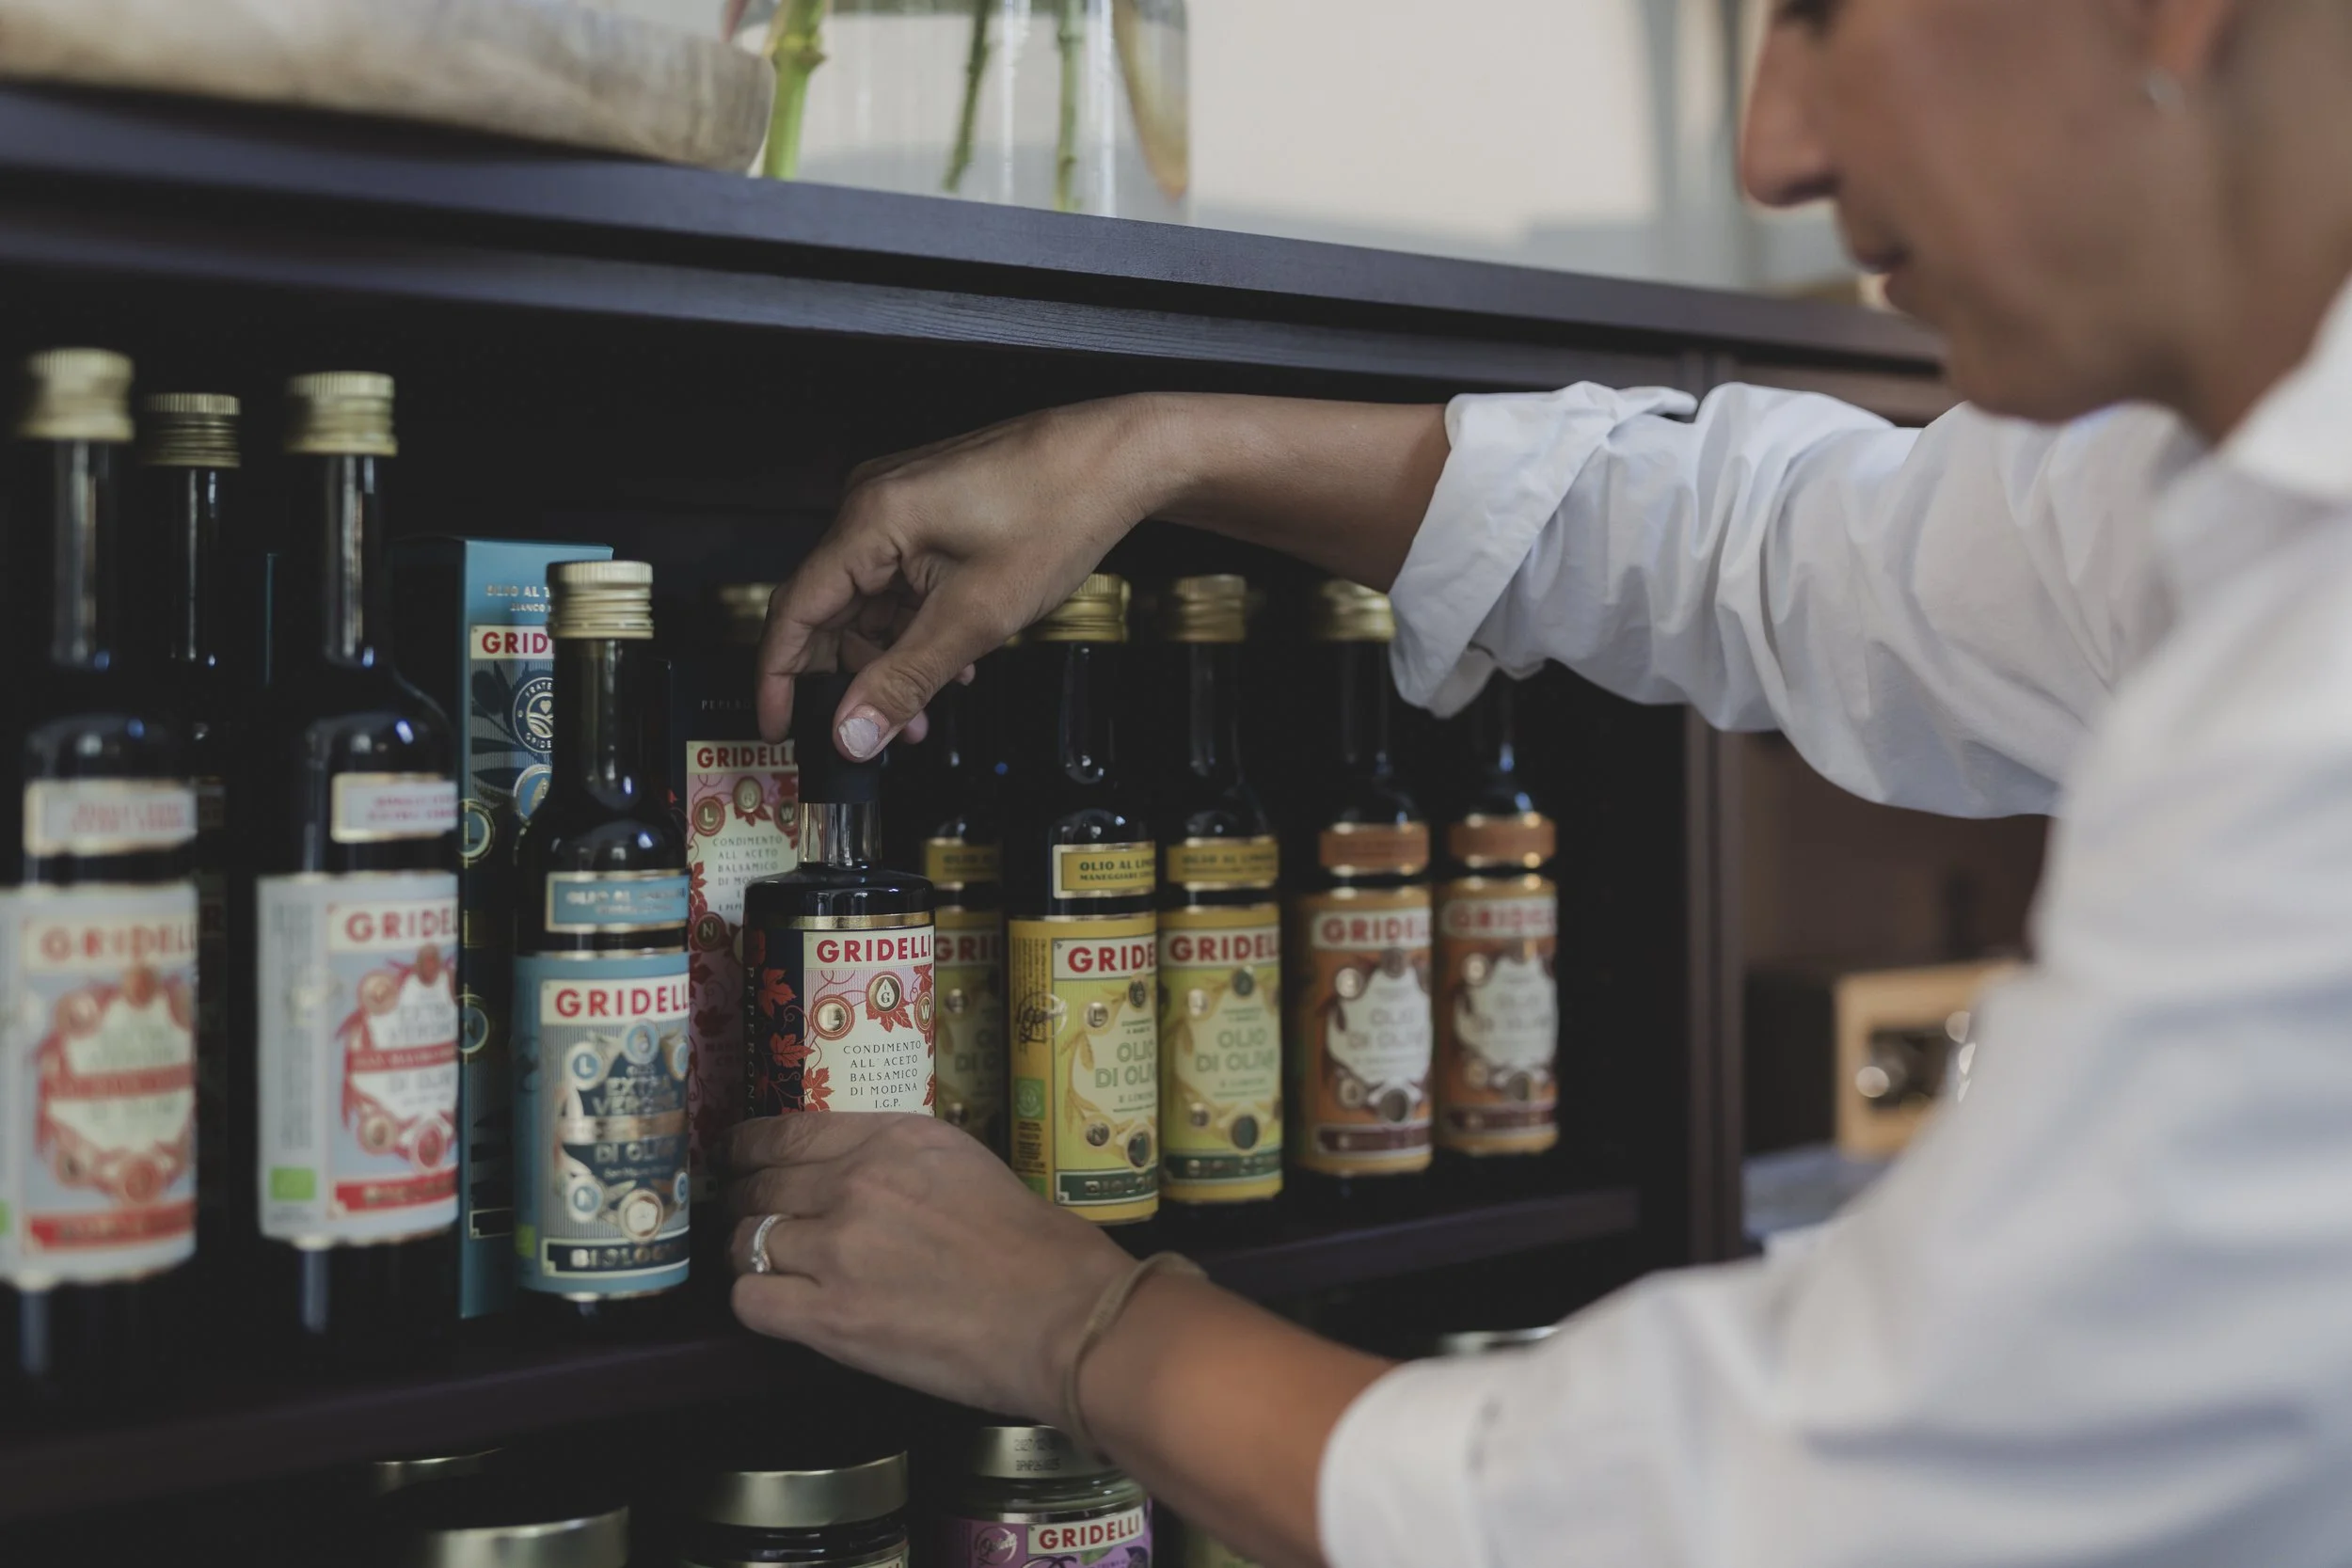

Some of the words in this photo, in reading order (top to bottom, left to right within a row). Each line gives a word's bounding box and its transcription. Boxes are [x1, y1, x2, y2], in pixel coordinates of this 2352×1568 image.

[482, 632, 555, 655] GRID
[1080, 861, 1115, 871] OLIO
[817, 934, 931, 963] GRIDELLI
[843, 1039, 922, 1054] CONDIMENTO
[883, 1054, 918, 1067] ACETO
[850, 1068, 918, 1082] BALSAMICO
[850, 1085, 864, 1096] DI
[870, 1082, 918, 1096] MODENA
[875, 1098, 901, 1109] I.G.P.
[1039, 1514, 1140, 1550] GRIDELLI
